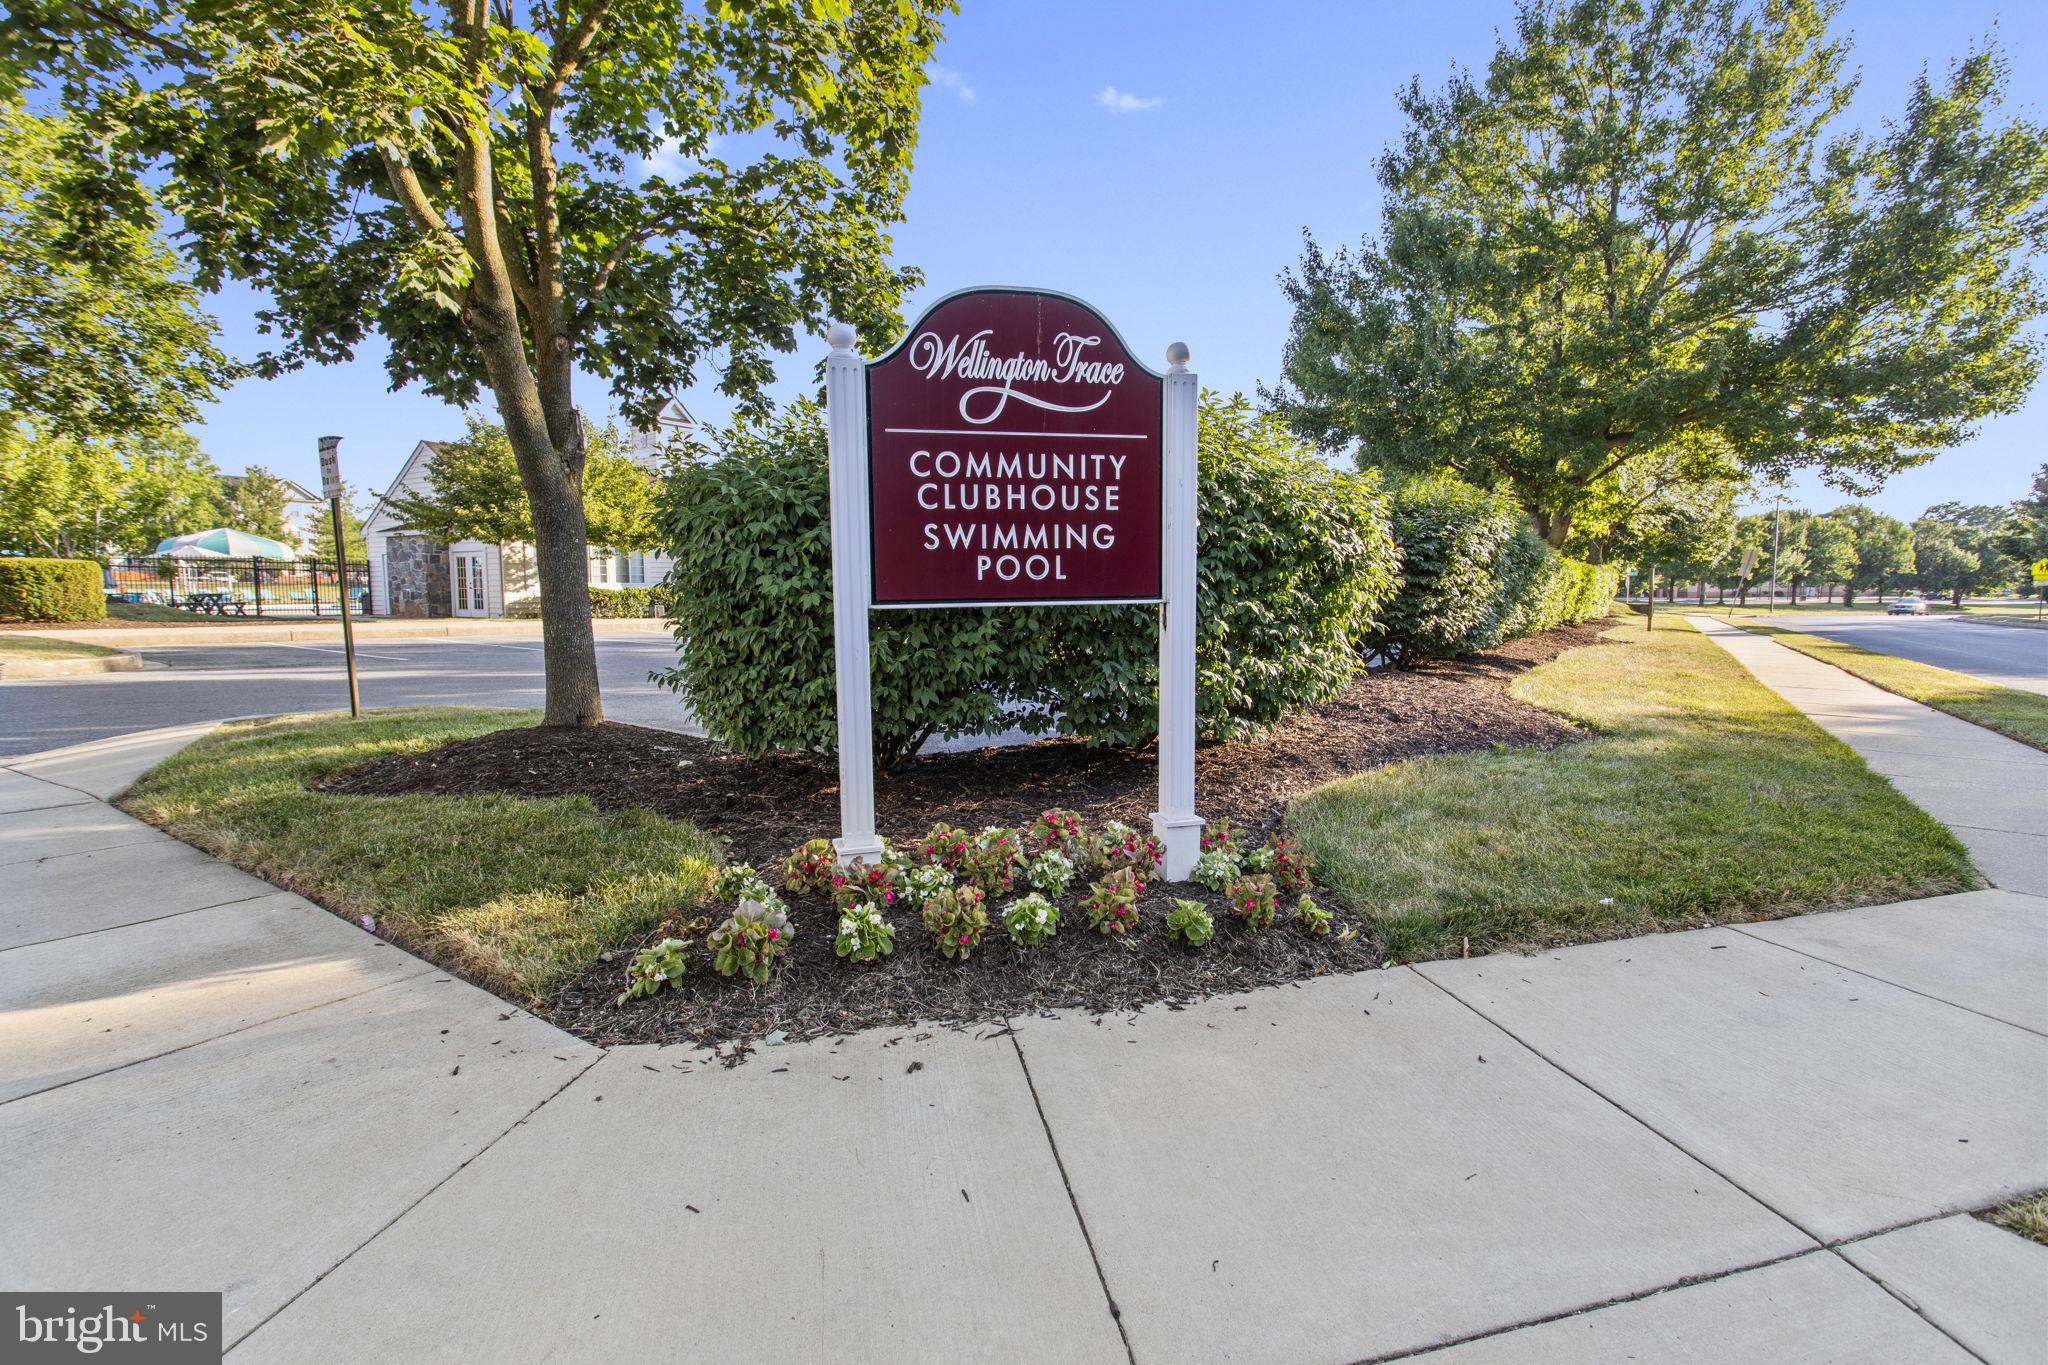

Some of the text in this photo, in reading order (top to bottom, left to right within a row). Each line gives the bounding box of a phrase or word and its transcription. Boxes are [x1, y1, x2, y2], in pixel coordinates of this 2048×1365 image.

[910, 330, 1125, 424] Wellington Trace
[909, 450, 1128, 481] COMMUNITY
[917, 483, 1120, 512] CLUBHOUSE
[923, 523, 1116, 551] SWIMMING
[976, 554, 1067, 582] POOL
